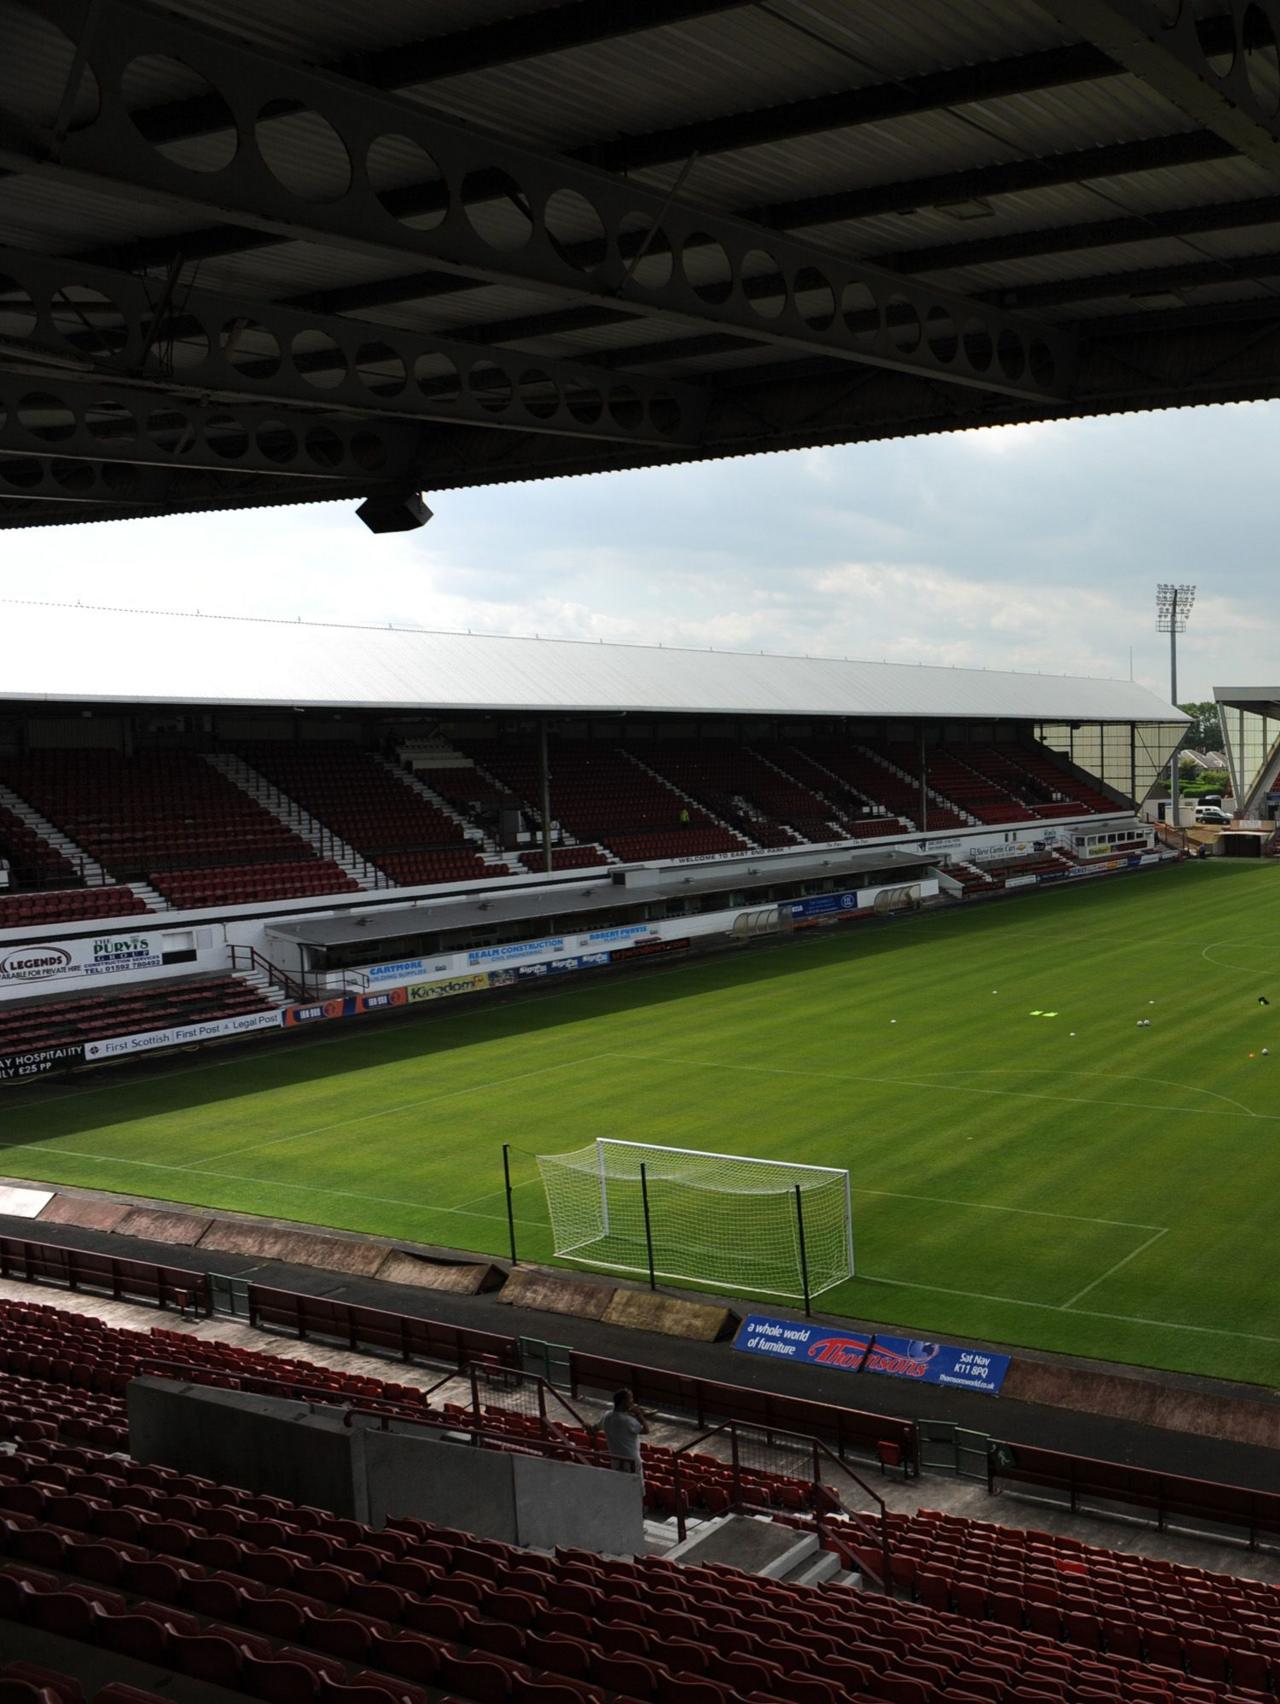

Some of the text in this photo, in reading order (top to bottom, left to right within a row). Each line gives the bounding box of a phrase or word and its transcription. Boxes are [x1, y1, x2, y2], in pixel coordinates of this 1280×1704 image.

[93, 939, 149, 955] PURVIS
[468, 939, 564, 960] REALM CONSTRUCTION
[0, 964, 81, 980] AILABLE FOR PRIVATE HIRE
[10, 956, 63, 971] LEGENDS
[83, 959, 131, 969] CONSTRUCTION
[369, 960, 422, 976] CARTMORE
[411, 981, 475, 999] Kingdom
[105, 1041, 129, 1053] First
[131, 1033, 170, 1049] Scottish
[175, 1028, 198, 1040] First
[199, 1024, 221, 1036] Post
[232, 1018, 256, 1030] Legal
[255, 1014, 279, 1026] Post
[16, 1046, 83, 1066] HOSPITALITY
[0, 1062, 52, 1079] LY £25 PP
[747, 1322, 811, 1342] a whole world
[747, 1337, 797, 1356] of furniture
[808, 1338, 929, 1377] Thomsons
[960, 1352, 991, 1366] Sat Nav
[971, 1365, 989, 1379] 8PQ
